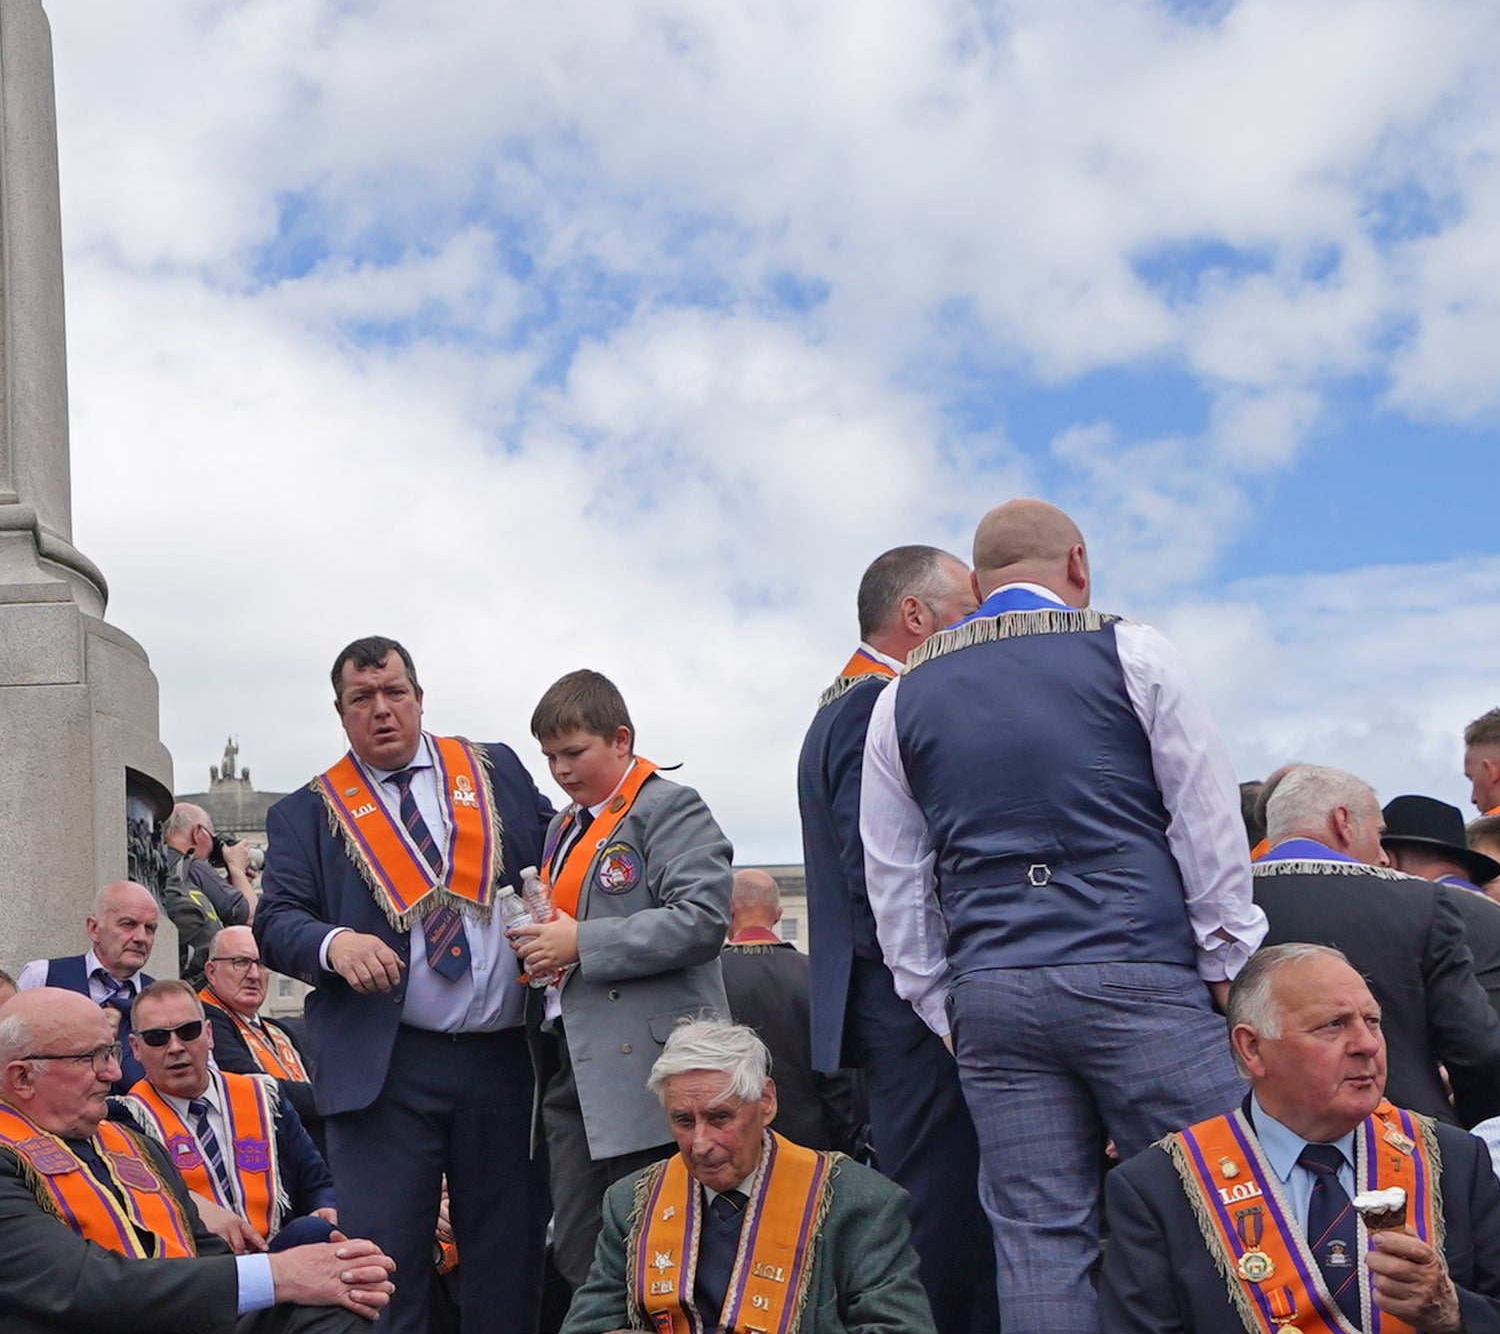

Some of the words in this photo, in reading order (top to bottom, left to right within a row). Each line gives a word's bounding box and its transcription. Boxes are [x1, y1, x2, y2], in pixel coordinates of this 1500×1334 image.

[351, 802, 377, 819] LOL
[238, 1145, 262, 1154] LOL
[1218, 1180, 1263, 1206] LOL
[752, 1262, 786, 1283] LOL
[751, 1294, 770, 1312] 91
